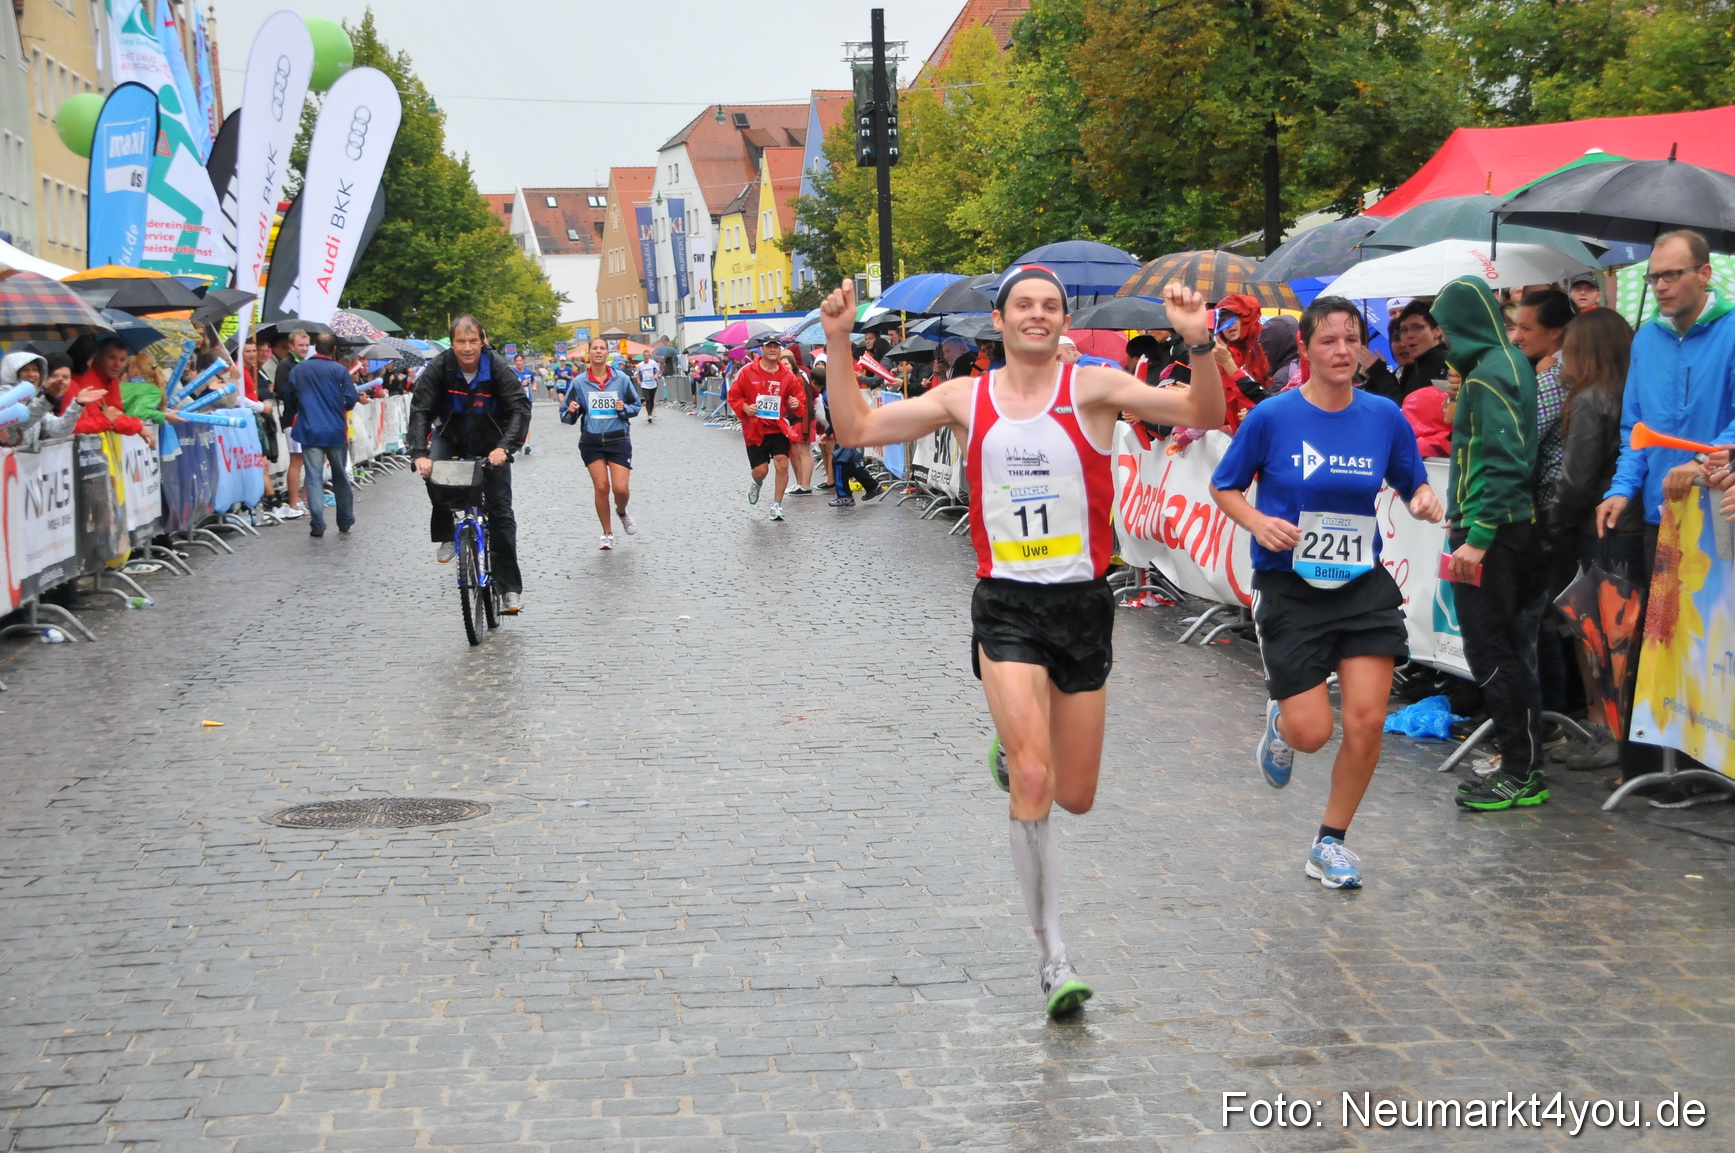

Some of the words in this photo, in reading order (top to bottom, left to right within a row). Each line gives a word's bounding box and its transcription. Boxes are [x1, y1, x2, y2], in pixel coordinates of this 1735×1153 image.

[109, 126, 146, 158] maxi
[253, 212, 268, 282] Audi
[263, 142, 278, 204] BKK
[316, 235, 341, 294] Audi
[331, 178, 354, 230] BKK
[592, 399, 616, 409] 2883
[758, 401, 778, 411] 2478
[1329, 455, 1373, 469] PLAST
[1010, 485, 1048, 497] BOCK
[1013, 504, 1049, 537] 11
[1322, 517, 1351, 526] BOCK
[1022, 545, 1048, 557] Uwe
[1302, 532, 1362, 562] 2241
[1315, 566, 1350, 579] Bettina
